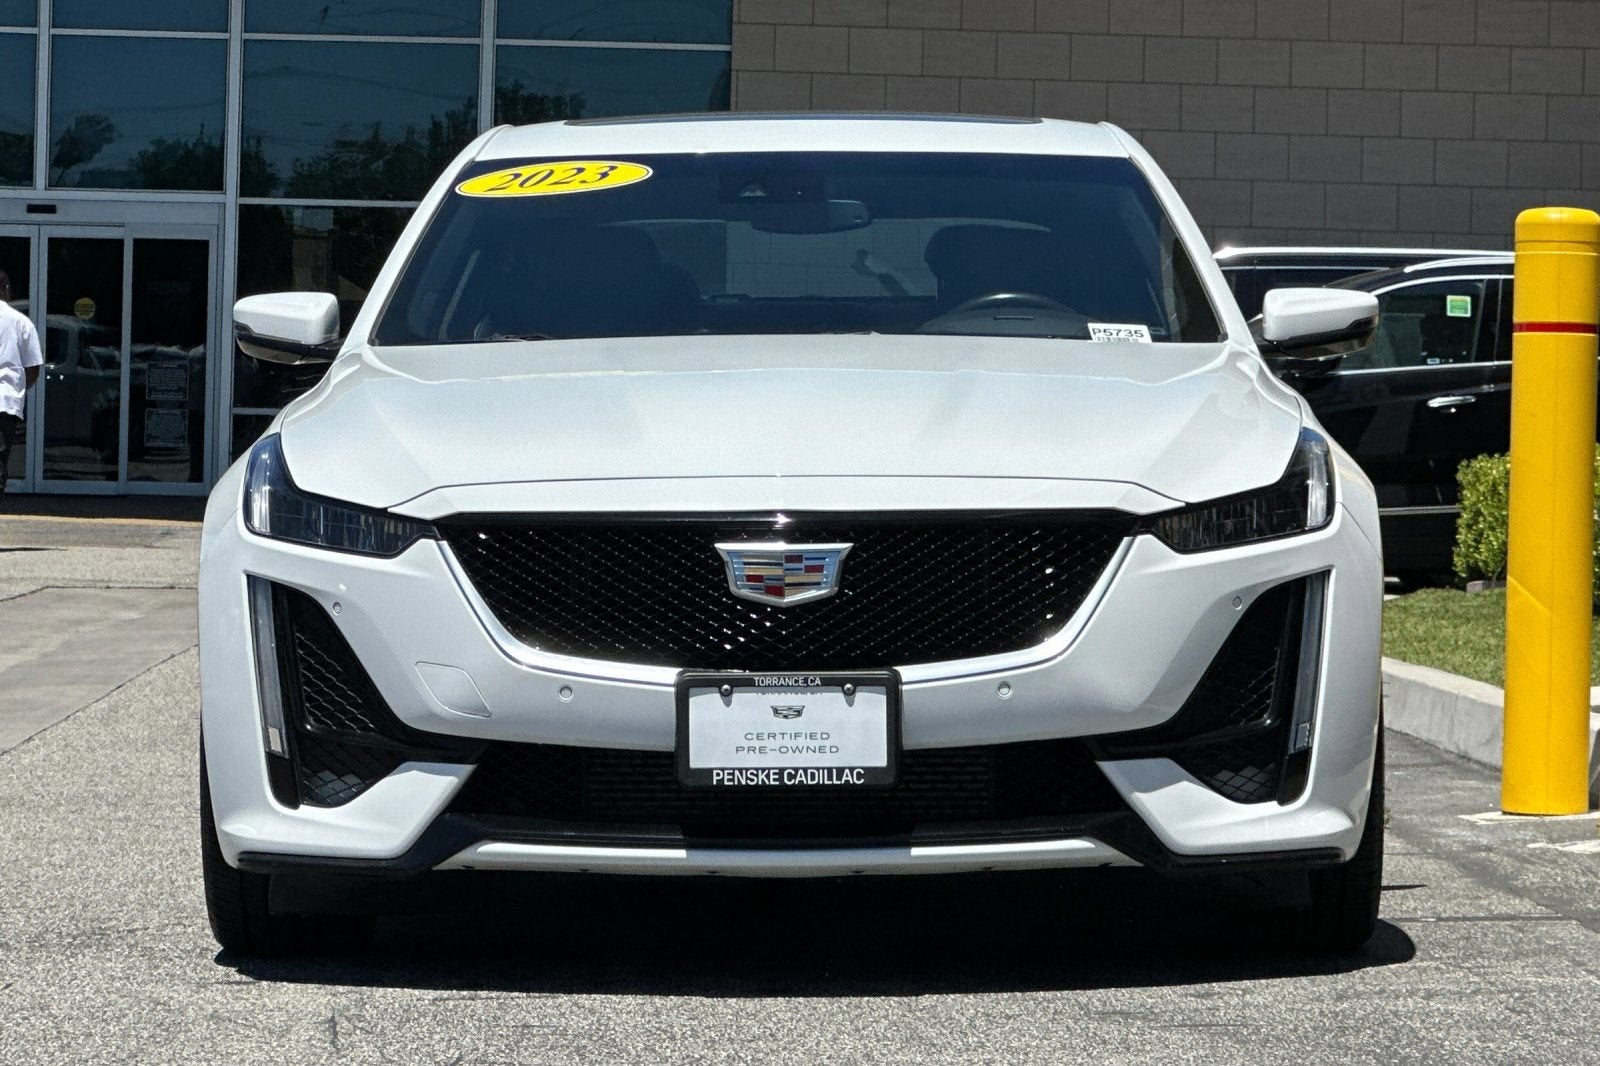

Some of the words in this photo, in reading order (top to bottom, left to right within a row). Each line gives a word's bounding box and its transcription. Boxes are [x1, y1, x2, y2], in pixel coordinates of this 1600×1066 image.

[483, 165, 619, 193] 2023
[1092, 327, 1145, 338] P5735
[744, 732, 831, 741] CERTIFIED
[735, 745, 840, 755] PRE-OWNED
[712, 769, 780, 786] PENSKE
[783, 768, 865, 785] CADILLAC
